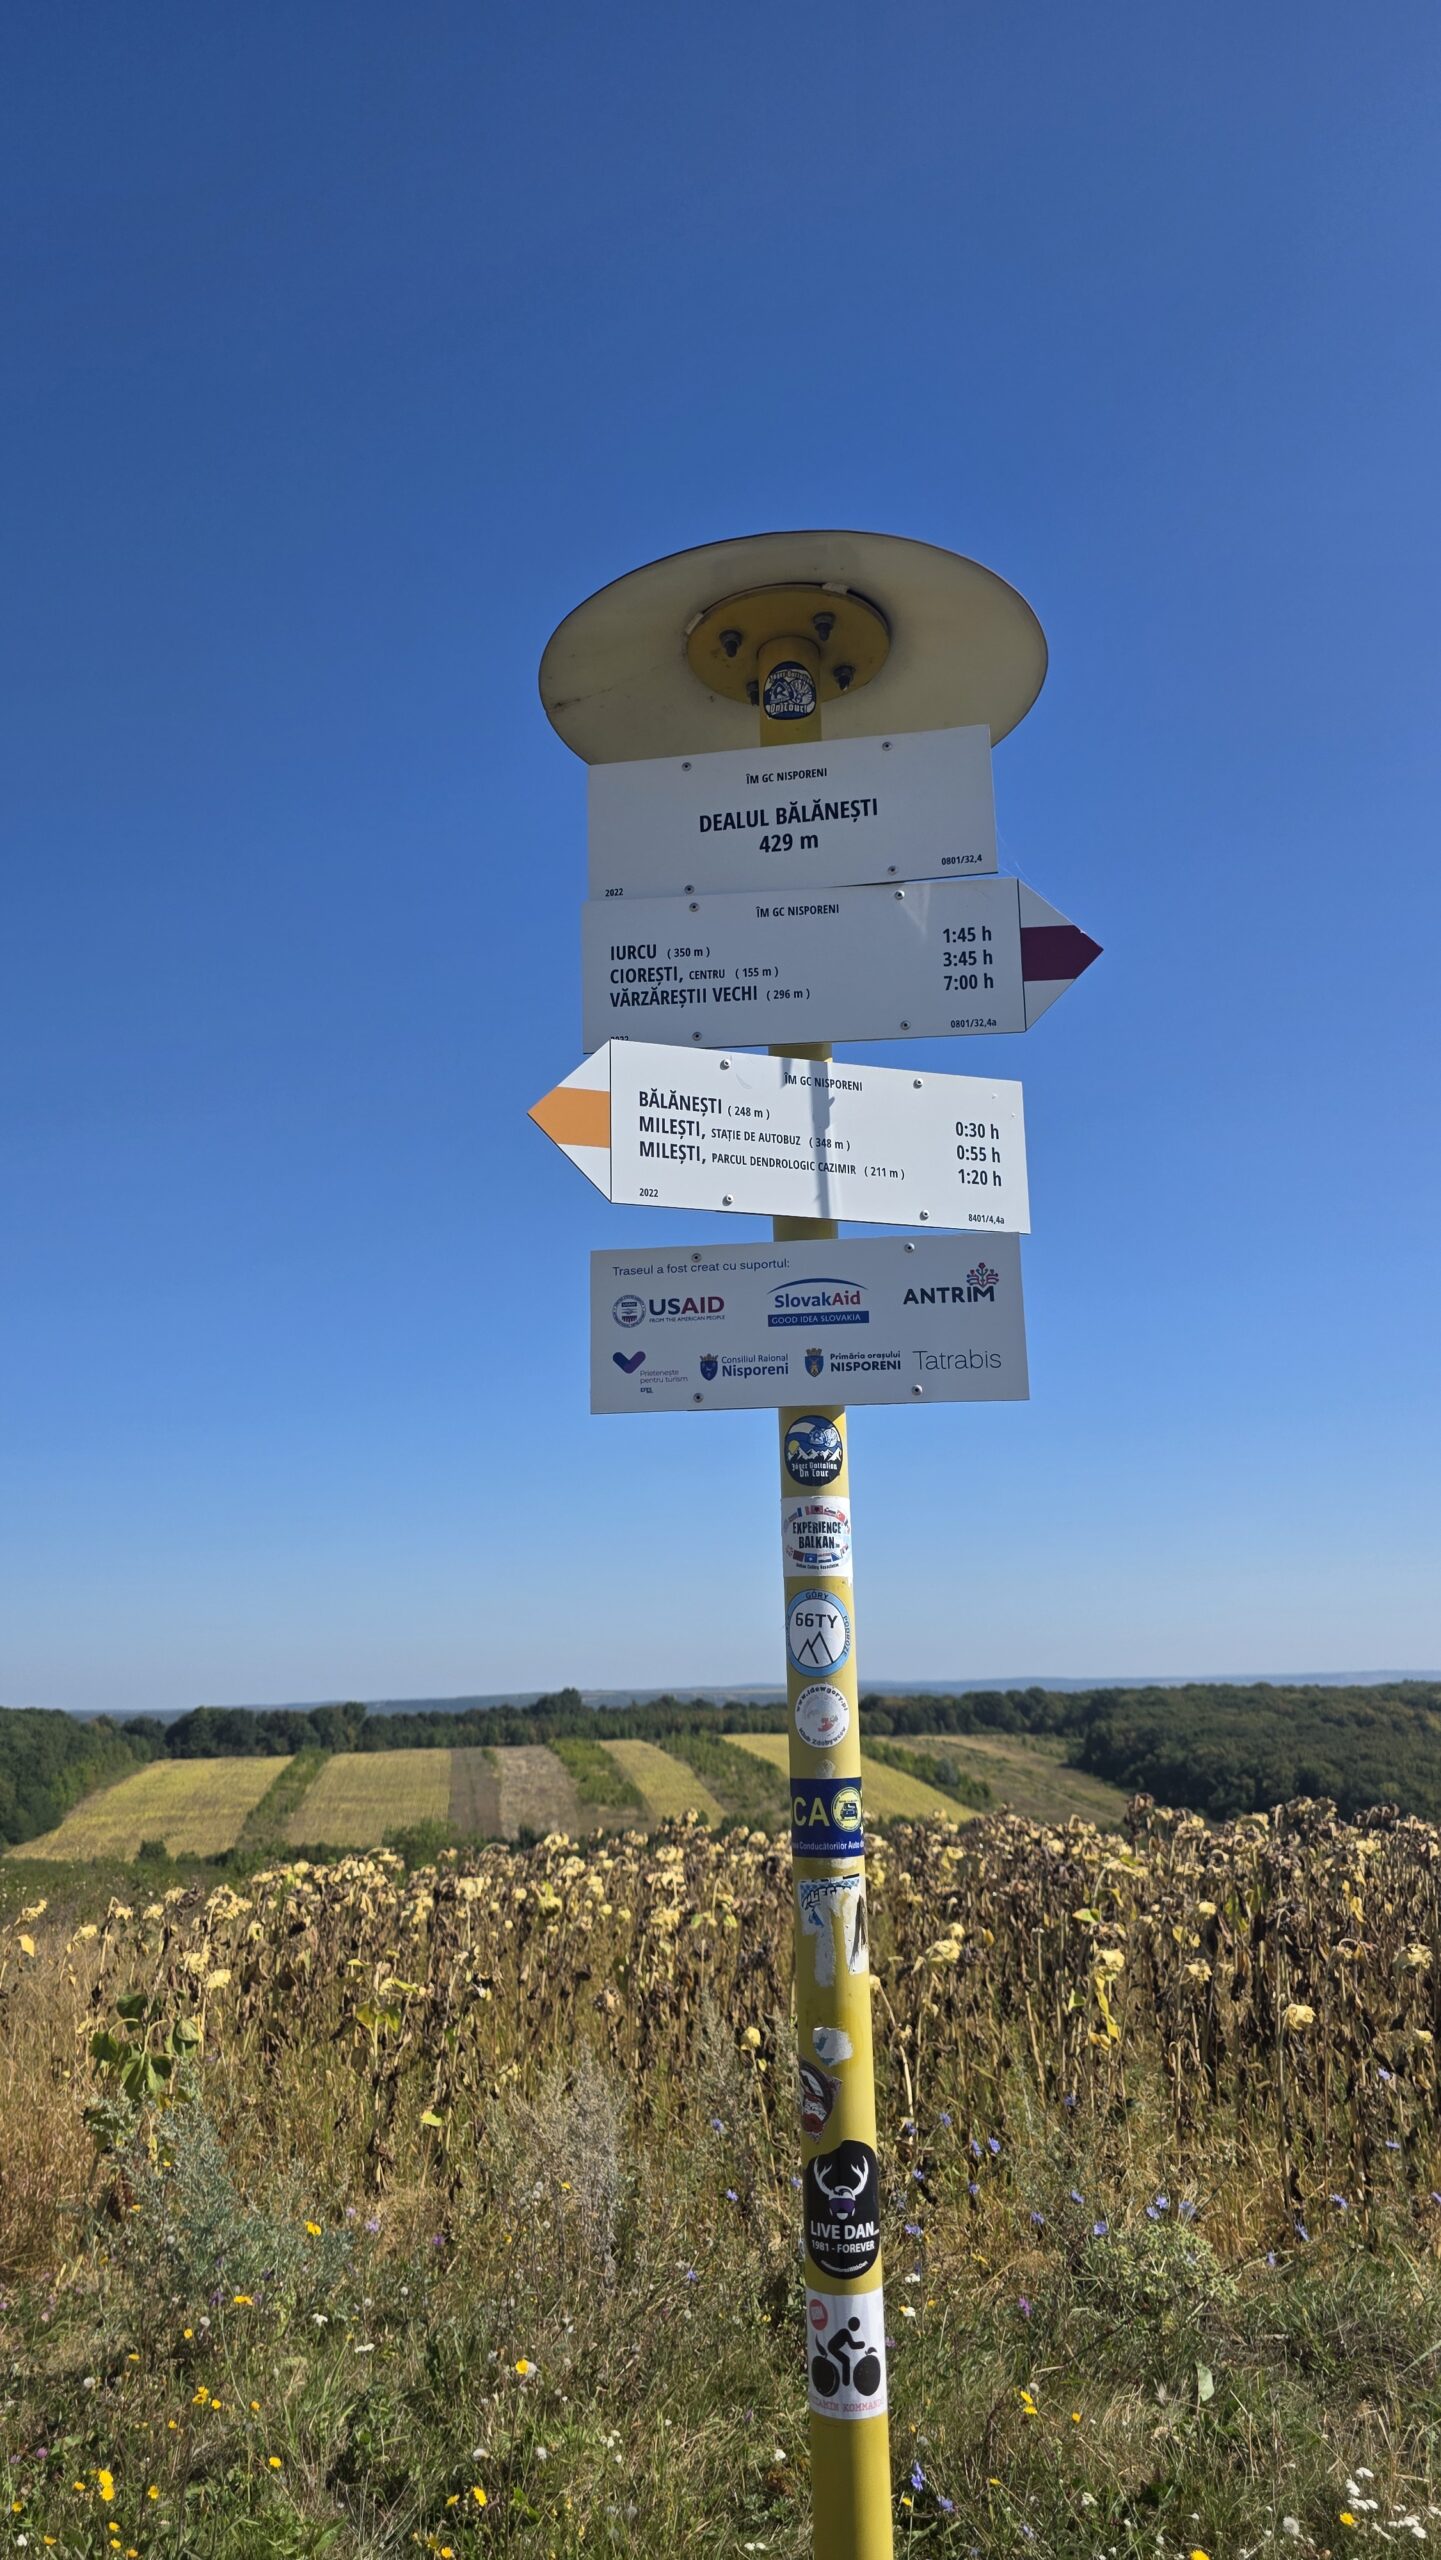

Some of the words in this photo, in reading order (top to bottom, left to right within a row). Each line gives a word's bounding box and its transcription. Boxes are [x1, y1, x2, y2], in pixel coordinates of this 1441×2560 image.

[746, 774, 759, 784] ÎM
[762, 773, 774, 783] GC
[776, 768, 827, 781] NISPORENI
[700, 809, 769, 832] DEALUL
[776, 798, 878, 825] BĂLĂNEȘTI
[760, 833, 793, 853] 429
[800, 834, 819, 849] m
[941, 854, 982, 866] 0801/32,4
[605, 888, 624, 897] 2022
[756, 907, 769, 918] ÎM
[773, 907, 785, 917] GC
[788, 904, 839, 917] NISPORENI
[942, 927, 976, 943] 1:45
[982, 925, 992, 941] h
[610, 944, 657, 960] IURCU
[943, 950, 977, 967] 3:45
[983, 949, 993, 965] h
[610, 966, 684, 986] CIOREȘTI,
[689, 969, 725, 980] CENTRU
[943, 974, 978, 991] 7:00
[983, 972, 994, 989] h
[610, 987, 707, 1009] VĂRZĂREȘTII
[712, 985, 757, 1003] VECHI
[950, 1018, 997, 1028] 0801/32,4a
[784, 1071, 797, 1085] ÎM
[800, 1076, 812, 1086] GC
[814, 1077, 863, 1091] NISPORENI
[639, 1087, 722, 1117] BĂLĂNEȘTI
[639, 1115, 706, 1140] MILEȘTI,
[711, 1128, 741, 1142] STAȚIE
[744, 1131, 756, 1142] DE
[758, 1132, 801, 1146] AUTOBUZ
[955, 1121, 986, 1138] 0:30
[990, 1123, 999, 1140] h
[639, 1140, 706, 1165] MILEȘTI,
[712, 1152, 747, 1165] PARCUL
[750, 1156, 815, 1171] DENDROLOGIC
[818, 1162, 857, 1175] CAZIMIR
[957, 1145, 987, 1161] 0:55
[991, 1147, 1001, 1163] h
[958, 1169, 988, 1186] 1:20
[993, 1170, 1002, 1187] h
[639, 1188, 659, 1198] 2022
[968, 1213, 1005, 1225] 8401/4,4a
[612, 1265, 653, 1276] Traseul
[656, 1266, 664, 1274] a
[666, 1263, 688, 1274] fost
[690, 1262, 719, 1273] creat
[722, 1262, 737, 1271] cu
[740, 1258, 790, 1271] suportul:
[774, 1290, 861, 1308] SlovakAid
[903, 1286, 995, 1305] ANTRIM
[649, 1296, 725, 1316] USAID
[771, 1316, 798, 1325] GOOD
[800, 1315, 818, 1323] IDEA
[821, 1313, 861, 1323] SLOVAKIA
[721, 1354, 755, 1364] Consiliul
[759, 1353, 788, 1363] Raional
[830, 1360, 901, 1372] NISPORENI
[912, 1349, 1002, 1371] Tatrabis
[722, 1363, 789, 1379] Nisporeni
[792, 1521, 841, 1534] EXPERIENCE
[799, 1536, 834, 1549] BALKAN
[795, 1612, 838, 1628] 66TY
[811, 2220, 840, 2239] LIVE
[812, 2240, 829, 2252] 1981
[837, 2240, 875, 2253] FOREVER
